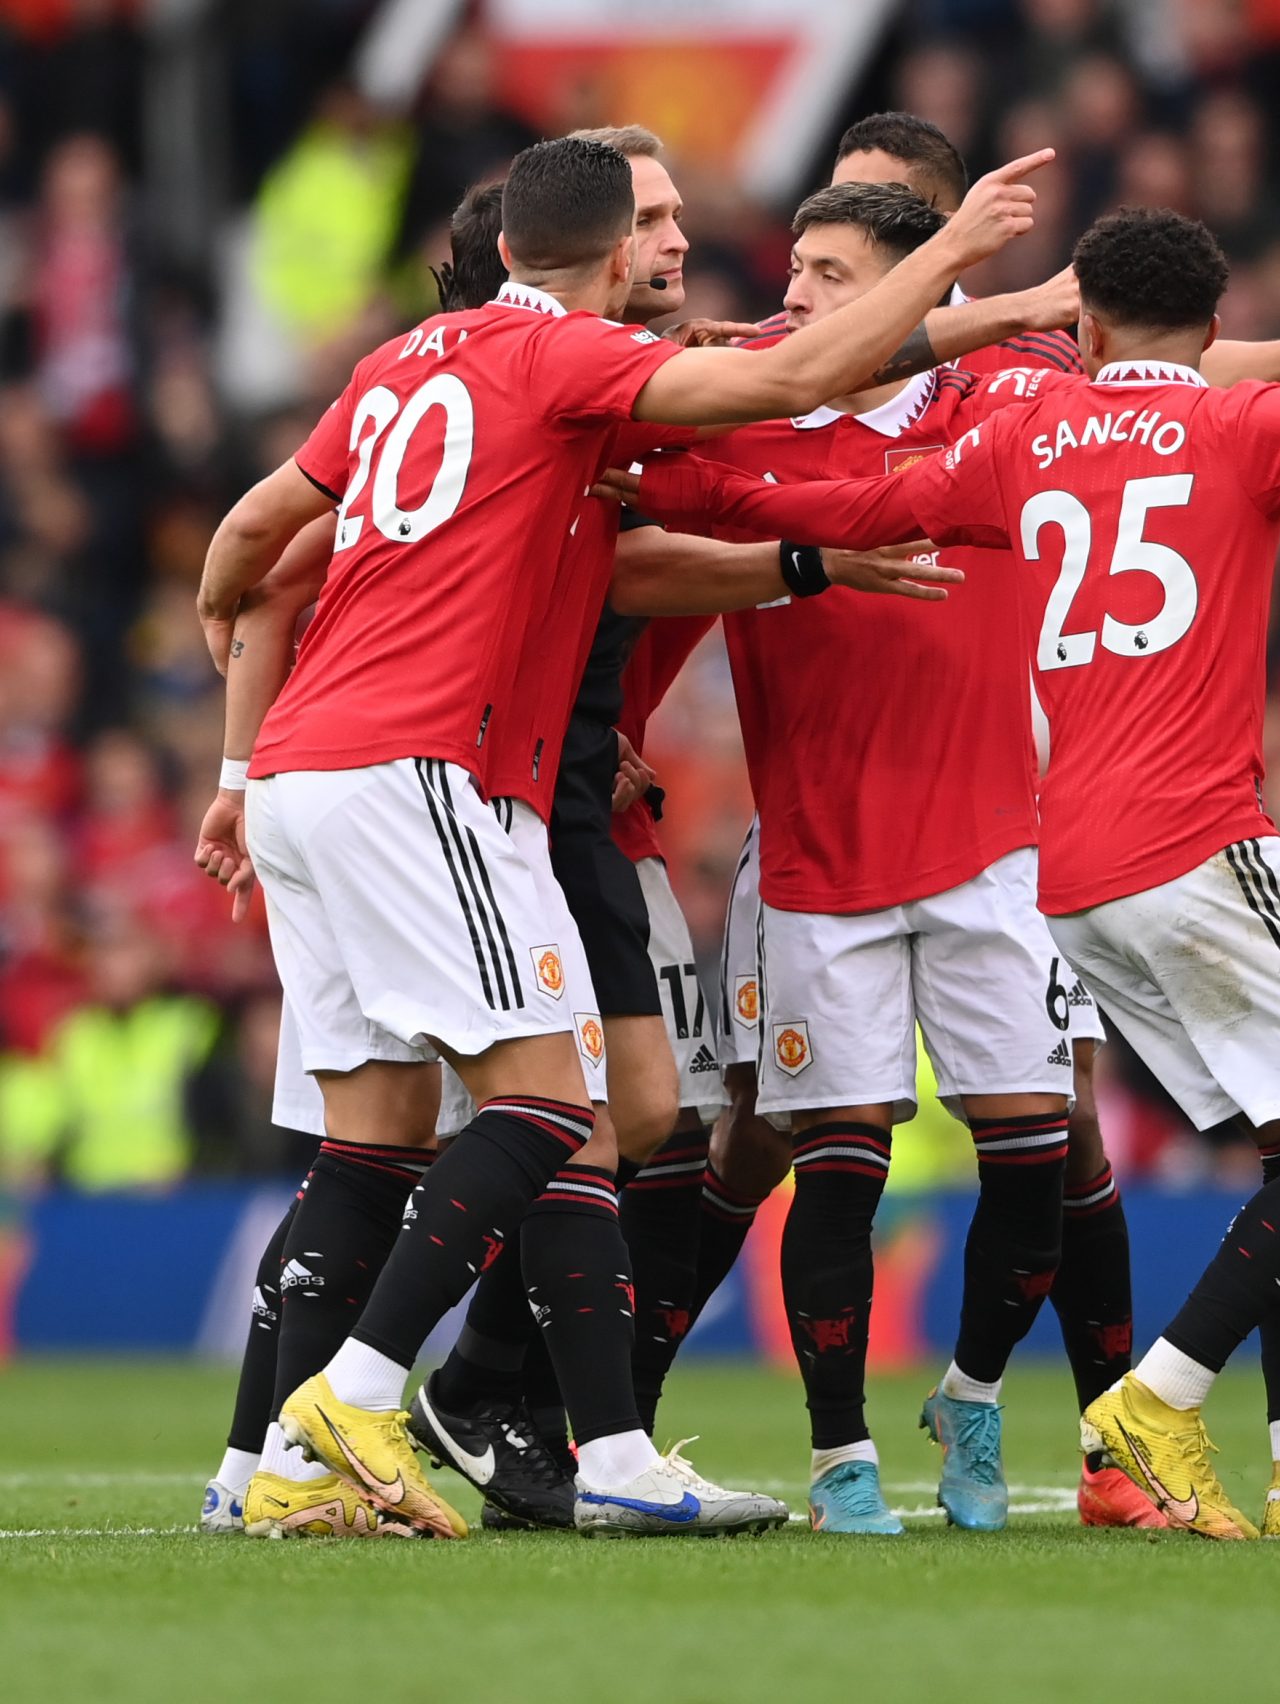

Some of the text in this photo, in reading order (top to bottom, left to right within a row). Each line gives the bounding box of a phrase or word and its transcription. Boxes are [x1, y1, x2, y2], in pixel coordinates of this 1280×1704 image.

[333, 373, 475, 554] 20
[1031, 409, 1186, 470] SANCHO
[1019, 473, 1198, 673] 25
[660, 963, 704, 1040] 17
[1046, 957, 1069, 1031] 6
